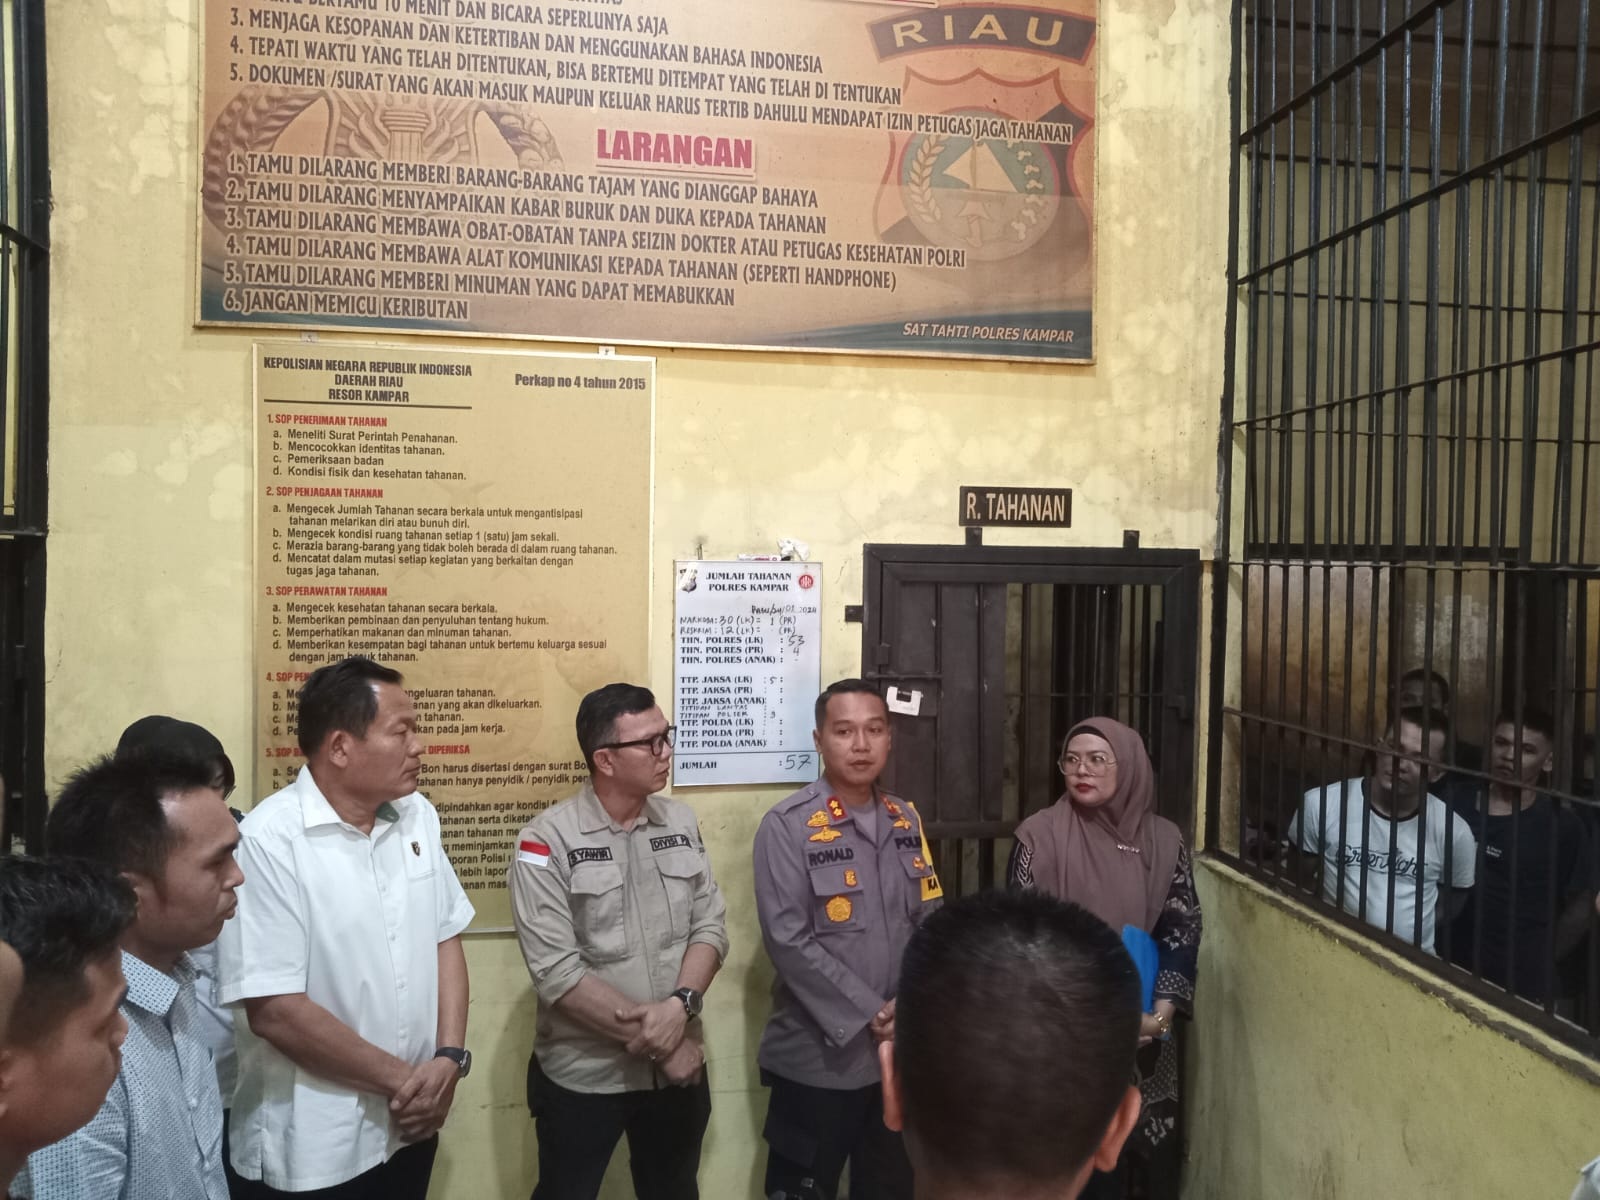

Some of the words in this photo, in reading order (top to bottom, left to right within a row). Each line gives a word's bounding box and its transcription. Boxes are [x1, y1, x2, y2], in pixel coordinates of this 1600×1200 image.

[893, 15, 1064, 47] RIAU
[231, 7, 244, 26] 3.
[249, 8, 321, 32] MENJAGA
[326, 15, 414, 39] KESOPANAN
[419, 23, 450, 42] DAN
[456, 26, 540, 49] KETERTIBAN
[545, 33, 575, 53] DAN
[580, 37, 688, 62] MENGGUNAKAN
[693, 46, 746, 67] BAHASA
[751, 51, 823, 73] INDONESIA
[230, 35, 244, 54] 4.
[249, 36, 299, 58] TEPATI
[304, 40, 356, 62] WAKTU
[361, 45, 402, 66] YANG
[407, 48, 451, 69] TELAH
[457, 53, 552, 77] DITENTUKAN,
[557, 60, 587, 80] BISA
[592, 63, 653, 85] BERTEMU
[659, 69, 725, 90] DITEMPAT
[729, 74, 766, 94] YANG
[770, 78, 810, 98] TELAH
[816, 81, 828, 99] DI
[833, 83, 901, 104] TENTUKAN
[598, 130, 752, 168] LARANGAN
[230, 154, 243, 171] 1.
[248, 153, 293, 174] TAMU
[299, 156, 377, 179] DILARANG
[383, 162, 451, 184] MEMBERI
[457, 167, 584, 192] BARANG-BARANG
[589, 175, 635, 197] TAJAM
[640, 179, 680, 199] YANG
[685, 182, 758, 203] DIANGGAP
[762, 187, 818, 208] BAHAYA
[228, 176, 243, 199] 2.
[247, 180, 293, 201] TAMU
[299, 184, 376, 206] DILARANG
[382, 189, 505, 213] MENYAMPAIKAN
[511, 197, 560, 217] KABAR
[565, 200, 615, 221] BURUK
[620, 204, 650, 223] DAN
[656, 206, 695, 226] DUKA
[700, 209, 754, 229] KEPADA
[759, 212, 826, 233] TAHANAN
[226, 232, 241, 254] 4.
[246, 236, 291, 256] TAMU
[298, 238, 376, 260] DILARANG
[381, 243, 461, 264] MEMBAWA
[466, 248, 504, 267] ALAT
[508, 250, 603, 272] KOMUNIKASI
[608, 256, 664, 276] KEPADA
[669, 259, 738, 280] TAHANAN
[743, 264, 800, 283] (SEPERTI
[805, 267, 897, 288] HANDPHONE)
[225, 287, 240, 309] 6.
[244, 291, 309, 311] JANGAN
[314, 294, 377, 314] MEMICU
[383, 297, 468, 318] KERIBUTAN
[903, 322, 930, 335] SAT
[931, 324, 970, 338] TAHTI
[972, 326, 1020, 340] POLRES
[1023, 328, 1074, 342] KAMPAR
[264, 356, 323, 370] KEPOLISIAN
[326, 359, 367, 372] NEGARA
[370, 361, 416, 374] REPUBLIK
[420, 363, 472, 376] INDONESIA
[335, 374, 376, 386] DAERAH
[379, 375, 403, 387] RIAU
[515, 373, 555, 387] Perkap
[558, 377, 572, 387] no
[574, 375, 581, 388] 4
[584, 376, 616, 388] tahun
[619, 377, 646, 390] 2015
[329, 388, 363, 400] RESOR
[365, 390, 409, 402] KAMPAR
[276, 413, 292, 424] SOP
[294, 414, 346, 425] PENERIMAAN
[348, 416, 387, 426] TAHANAN
[273, 430, 282, 438] a.
[288, 428, 326, 439] Meneliti
[329, 430, 355, 440] Surat
[358, 430, 398, 441] Perintah
[402, 432, 458, 443] Penahanan.
[273, 440, 282, 450] b.
[288, 441, 356, 452] Mencocokkan
[359, 443, 401, 454] identitas
[404, 445, 445, 455] tahanan.
[273, 454, 282, 463] c.
[288, 453, 351, 464] Pemeriksaan
[354, 456, 384, 465] badan
[273, 465, 282, 475] d.
[288, 466, 326, 476] Kondisi
[329, 466, 350, 477] fisik
[352, 467, 370, 478] dan
[373, 468, 422, 479] kesehatan
[425, 470, 467, 480] tahanan.
[266, 486, 274, 496] 2.
[276, 486, 293, 496] SOP
[294, 487, 342, 497] PENJAGAAN
[344, 488, 383, 498] TAHANAN
[967, 492, 981, 519] R.
[986, 493, 1065, 521] TAHANAN
[273, 527, 282, 537] b.
[287, 528, 336, 539] Mengecek
[338, 529, 373, 539] kondisi
[376, 531, 403, 542] ruang
[405, 530, 442, 540] tahanan
[445, 531, 473, 542] setiap
[476, 531, 480, 540] 1
[484, 531, 510, 542] (satu)
[512, 531, 528, 544] jam
[531, 532, 560, 541] sekali.
[266, 586, 274, 596] 3.
[276, 585, 294, 596] SOP
[294, 586, 347, 596] PERAWATAN
[349, 586, 388, 596] TAHANAN
[273, 614, 282, 624] b.
[287, 614, 345, 624] Memberikan
[348, 614, 400, 625] pembinaan
[402, 615, 420, 624] dan
[422, 616, 476, 627] penyuluhan
[479, 615, 513, 627] tentang
[515, 615, 550, 625] hukum.
[680, 761, 717, 769] JUMLAH
[808, 848, 854, 866] RONALD
